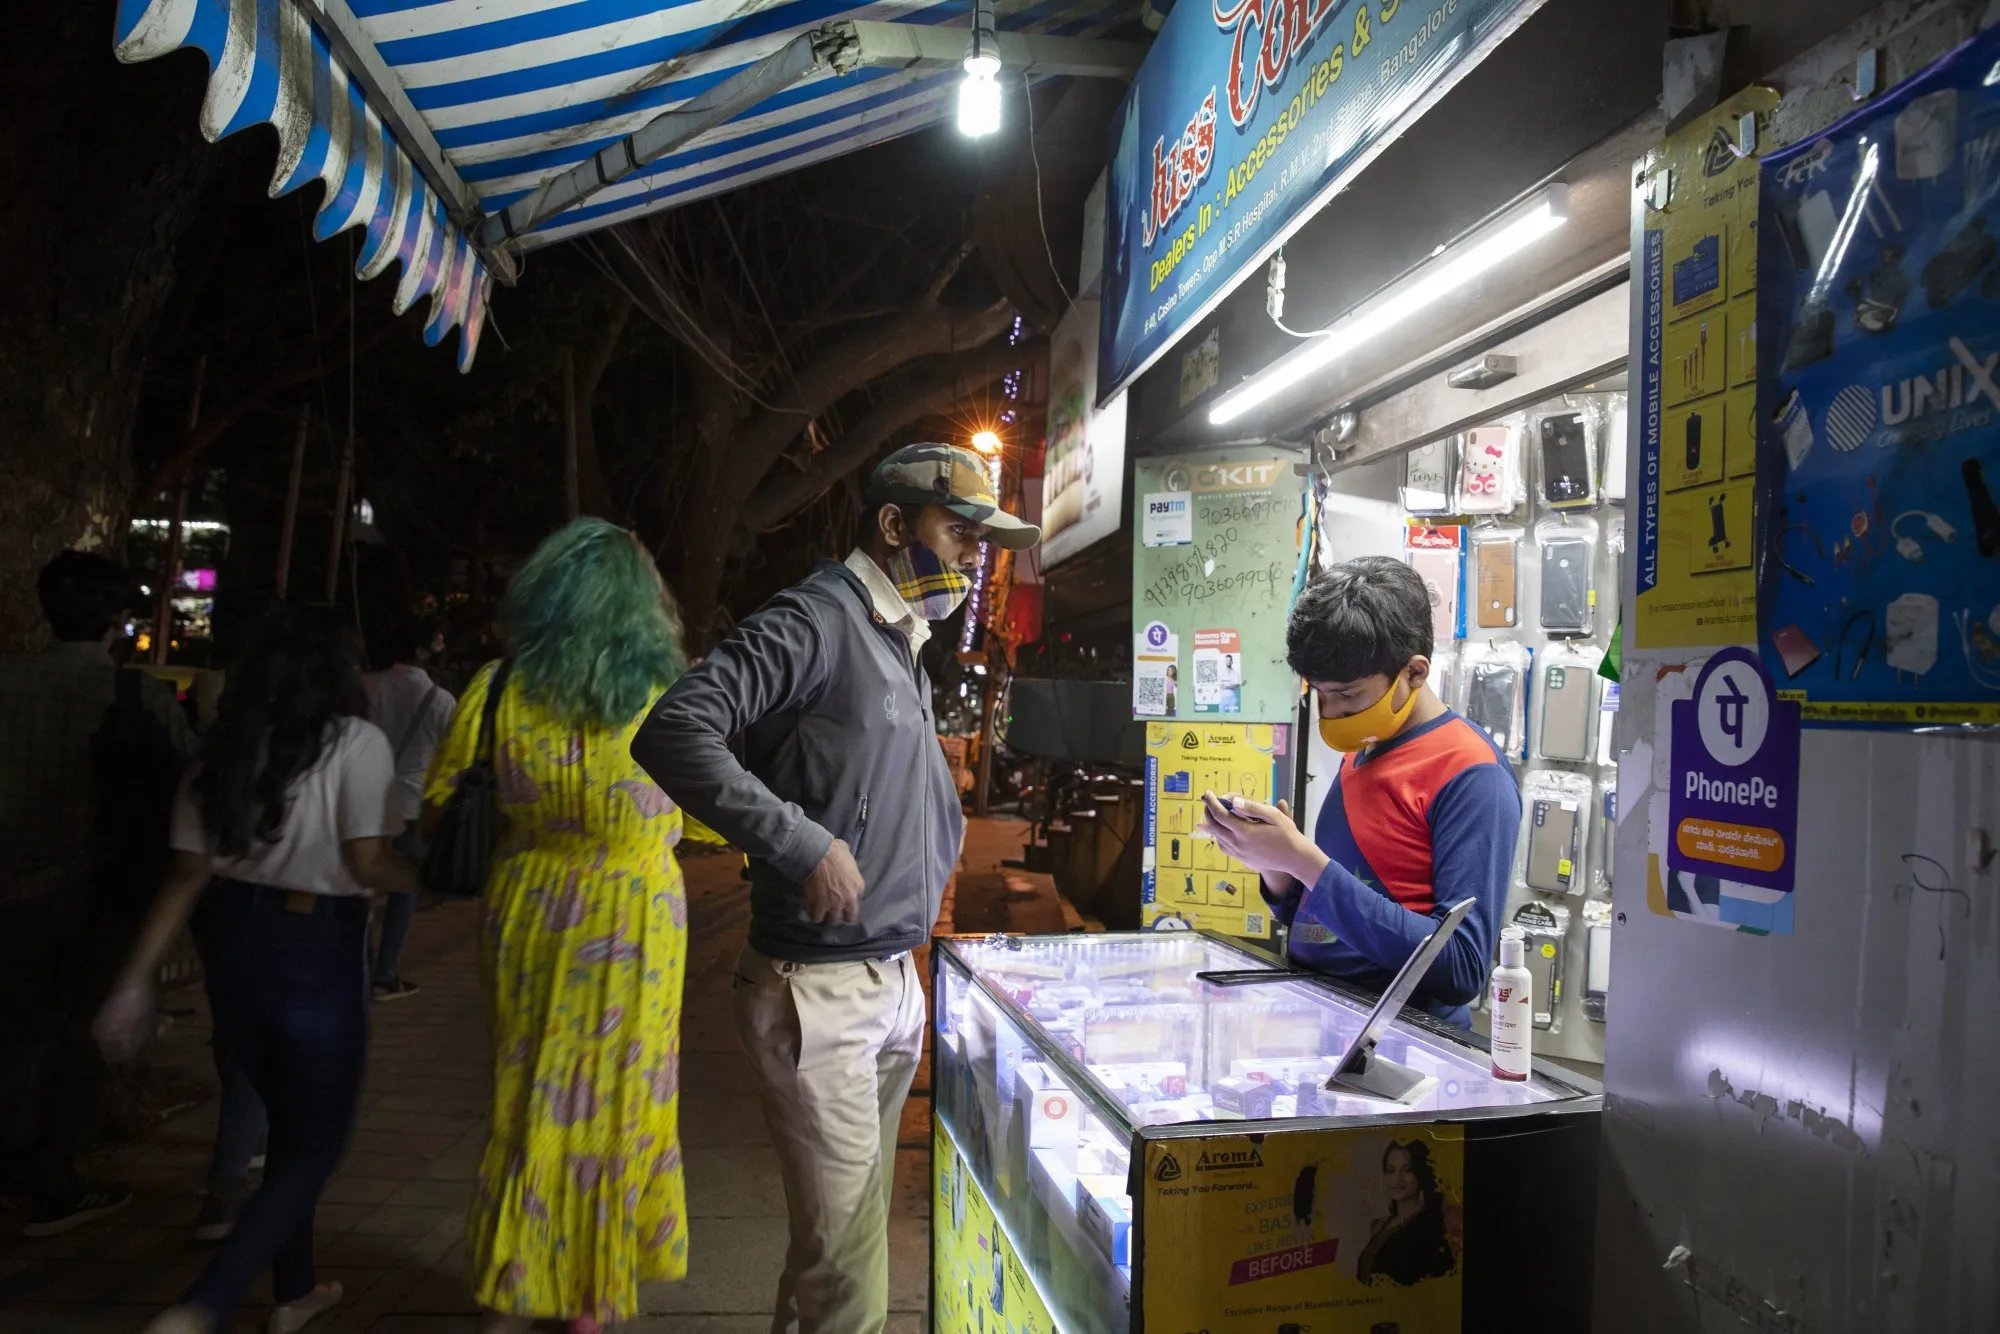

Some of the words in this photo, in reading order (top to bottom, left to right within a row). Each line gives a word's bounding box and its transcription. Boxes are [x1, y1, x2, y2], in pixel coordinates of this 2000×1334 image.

[1149, 223, 1196, 294] Dealers
[1199, 203, 1212, 238] In
[1224, 44, 1343, 208] Accessories
[1352, 6, 1371, 57] &
[1157, 293, 1177, 322] Casino
[1203, 249, 1217, 274] Opp
[1219, 221, 1241, 258] M.S.R
[1312, 117, 1335, 156] 2nd
[1380, 0, 1458, 87] Bangalore
[1703, 185, 1735, 209] Taking
[1737, 174, 1756, 191] You
[1650, 231, 1661, 366] ACCESSORIES
[1648, 371, 1660, 445] MOBILE
[1881, 336, 2000, 426] UNIX
[1647, 451, 1658, 476] OF
[1645, 480, 1658, 545] TYPES
[1644, 549, 1656, 586] ALL
[1715, 674, 1749, 749] पे
[1149, 758, 1157, 813] ACCESSORIES
[1686, 770, 1778, 809] PhonePe
[1157, 1187, 1189, 1196] Taking
[1192, 1185, 1210, 1194] You
[1249, 1248, 1314, 1278] BEFORE
[1224, 1307, 1263, 1317] Exclusive
[1265, 1303, 1292, 1314] Range
[1293, 1302, 1301, 1311] of
[1304, 1300, 1344, 1310] Bluetooth
[1346, 1296, 1383, 1307] Speakers
